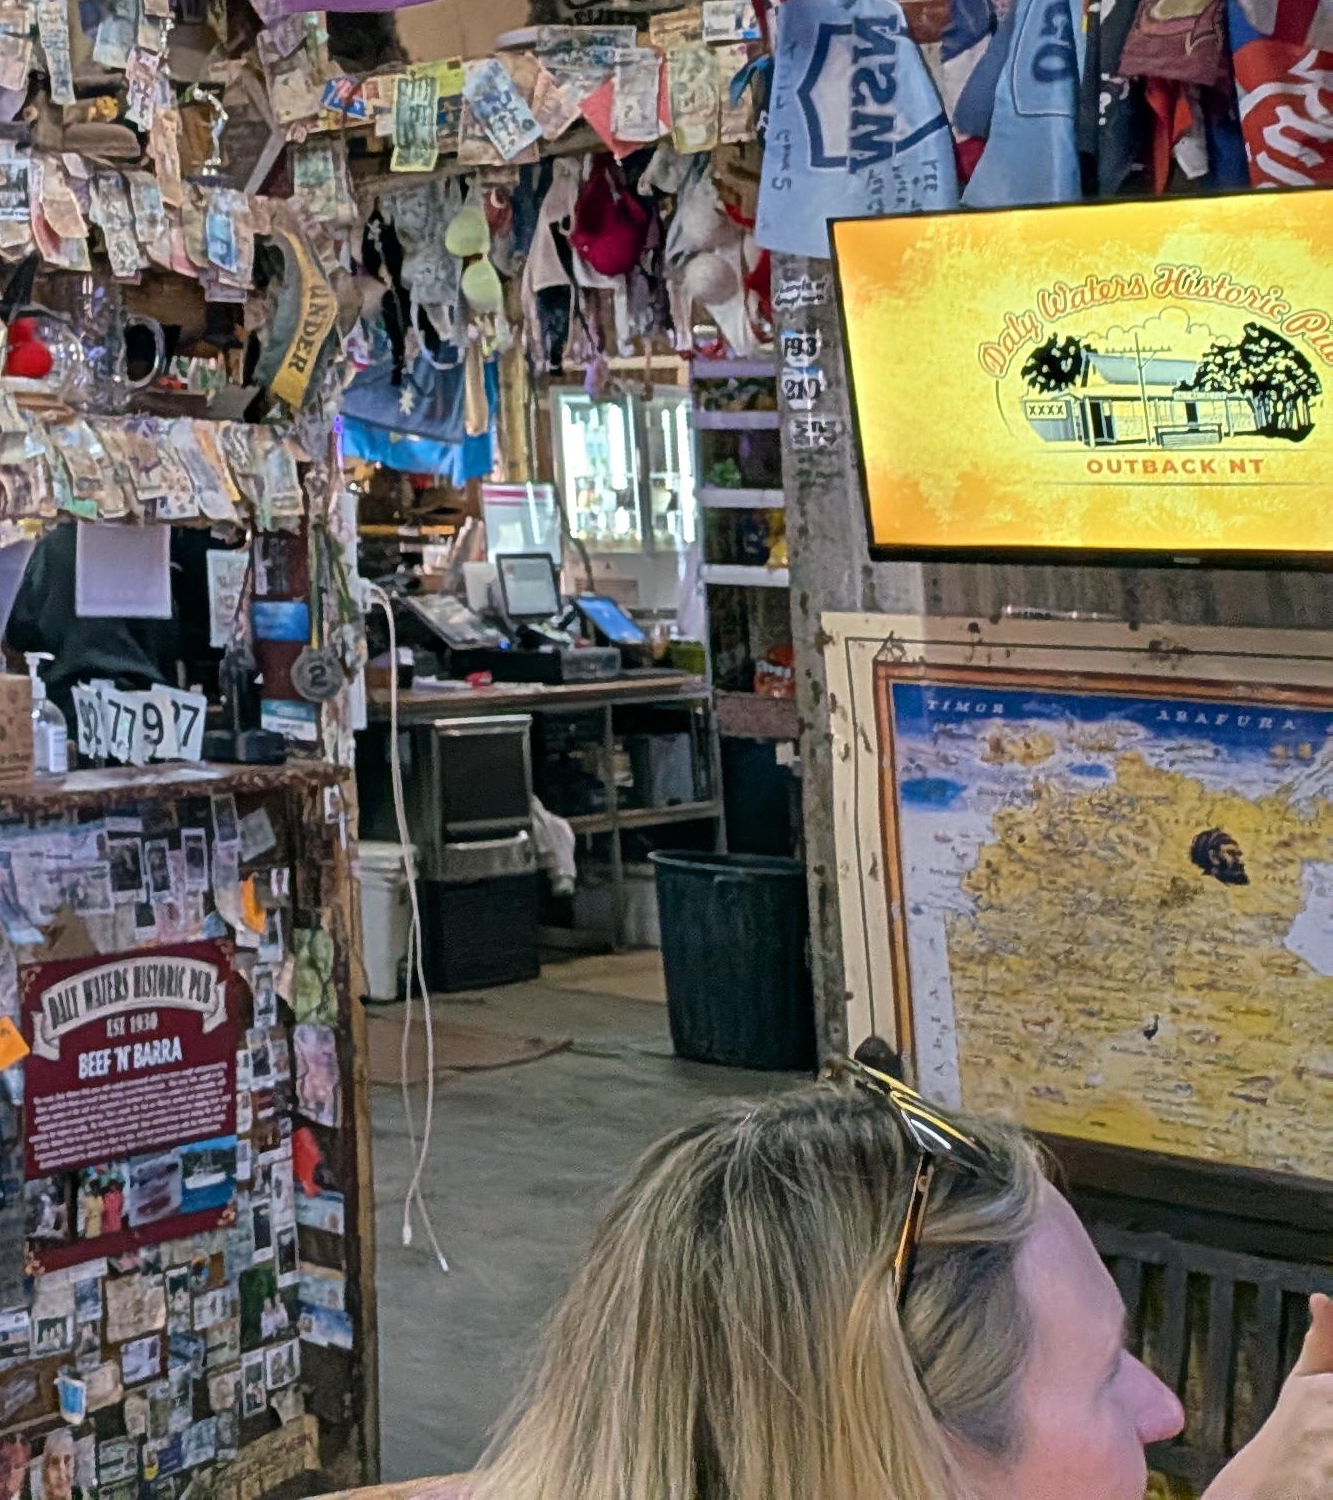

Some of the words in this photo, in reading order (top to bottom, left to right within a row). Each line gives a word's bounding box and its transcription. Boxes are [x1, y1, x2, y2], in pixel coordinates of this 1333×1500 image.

[288, 283, 332, 376] UNDER
[982, 312, 1042, 376] Daly
[1040, 276, 1146, 320] Waters
[1153, 266, 1289, 322] Historic
[1028, 404, 1065, 417] XXXX
[1086, 459, 1216, 475] OUTBACK
[1229, 459, 1265, 474] NT
[78, 1048, 112, 1080] BEEF
[133, 1035, 183, 1069] BARRA
